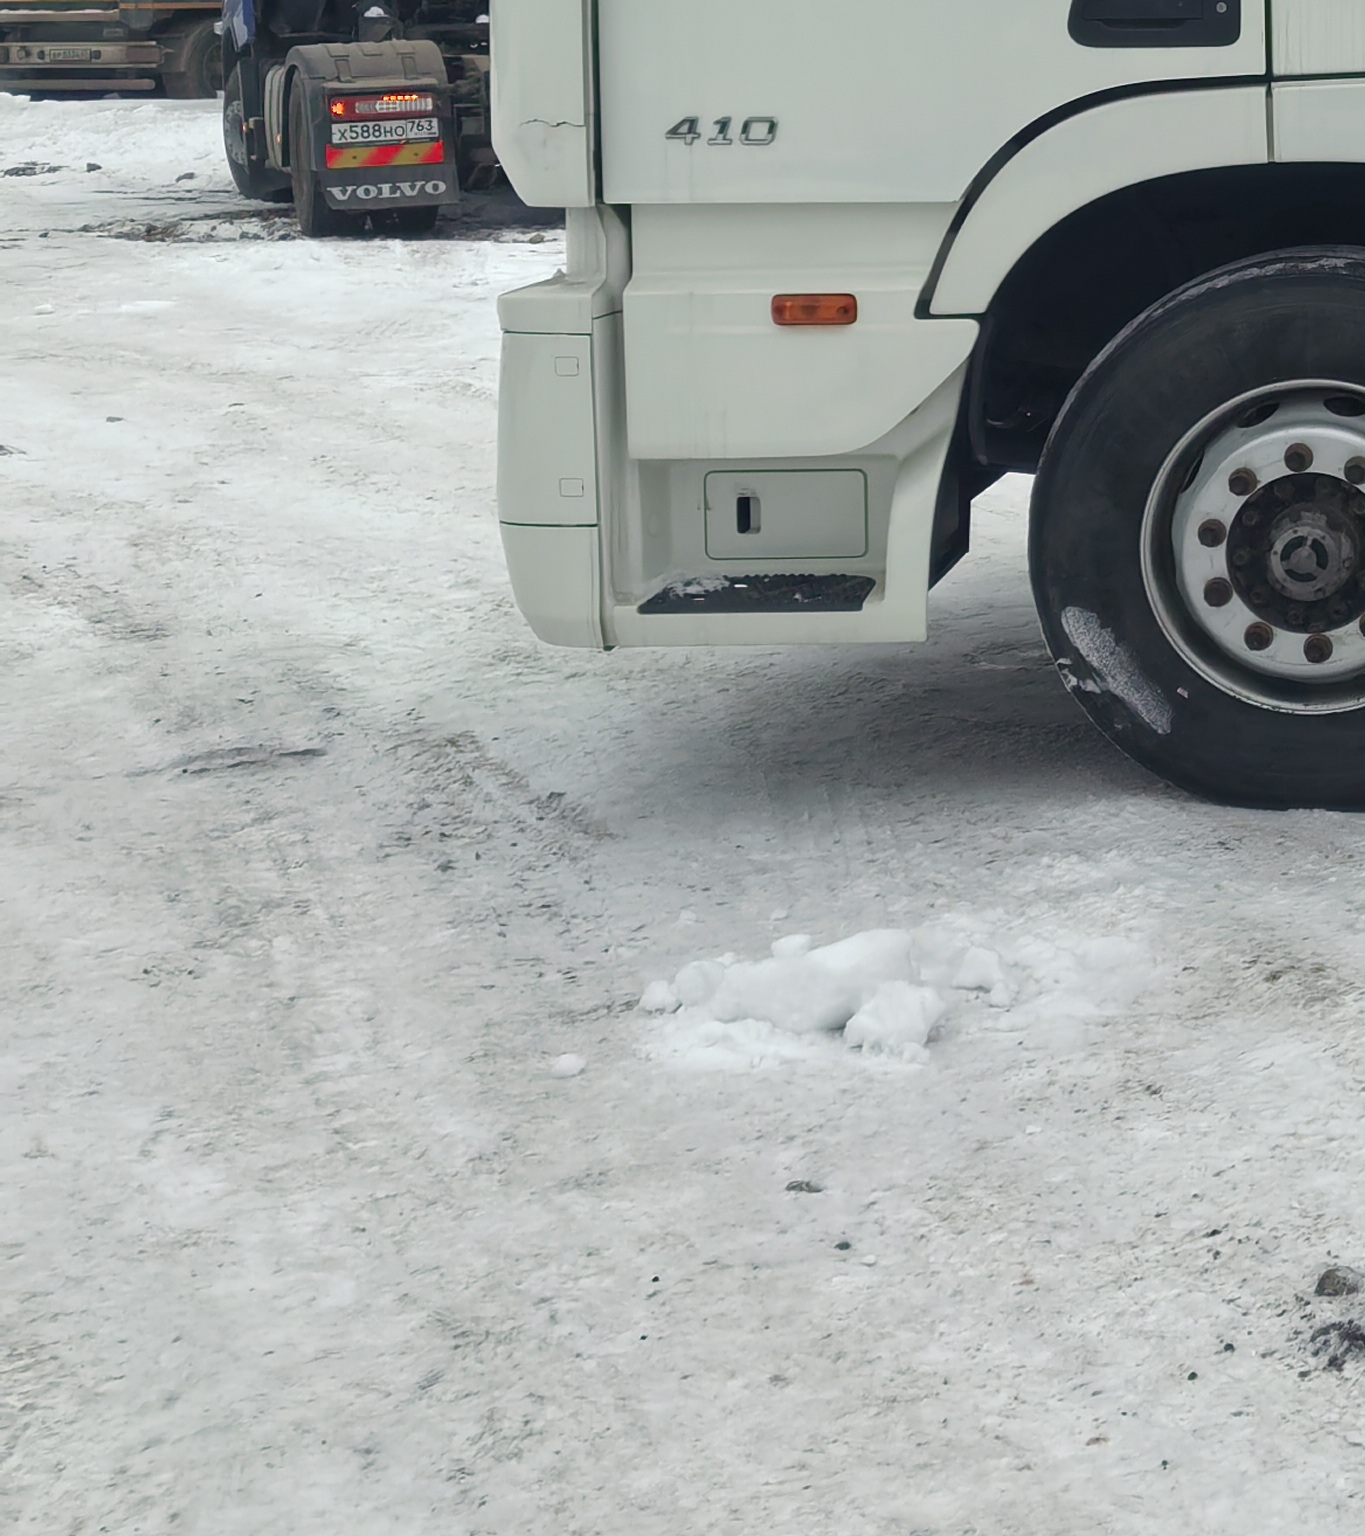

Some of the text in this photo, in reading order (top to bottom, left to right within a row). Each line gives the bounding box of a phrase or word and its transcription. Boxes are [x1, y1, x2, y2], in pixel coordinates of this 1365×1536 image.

[408, 120, 433, 133] 763
[665, 116, 779, 146] 410
[326, 180, 447, 201] VOLVO
